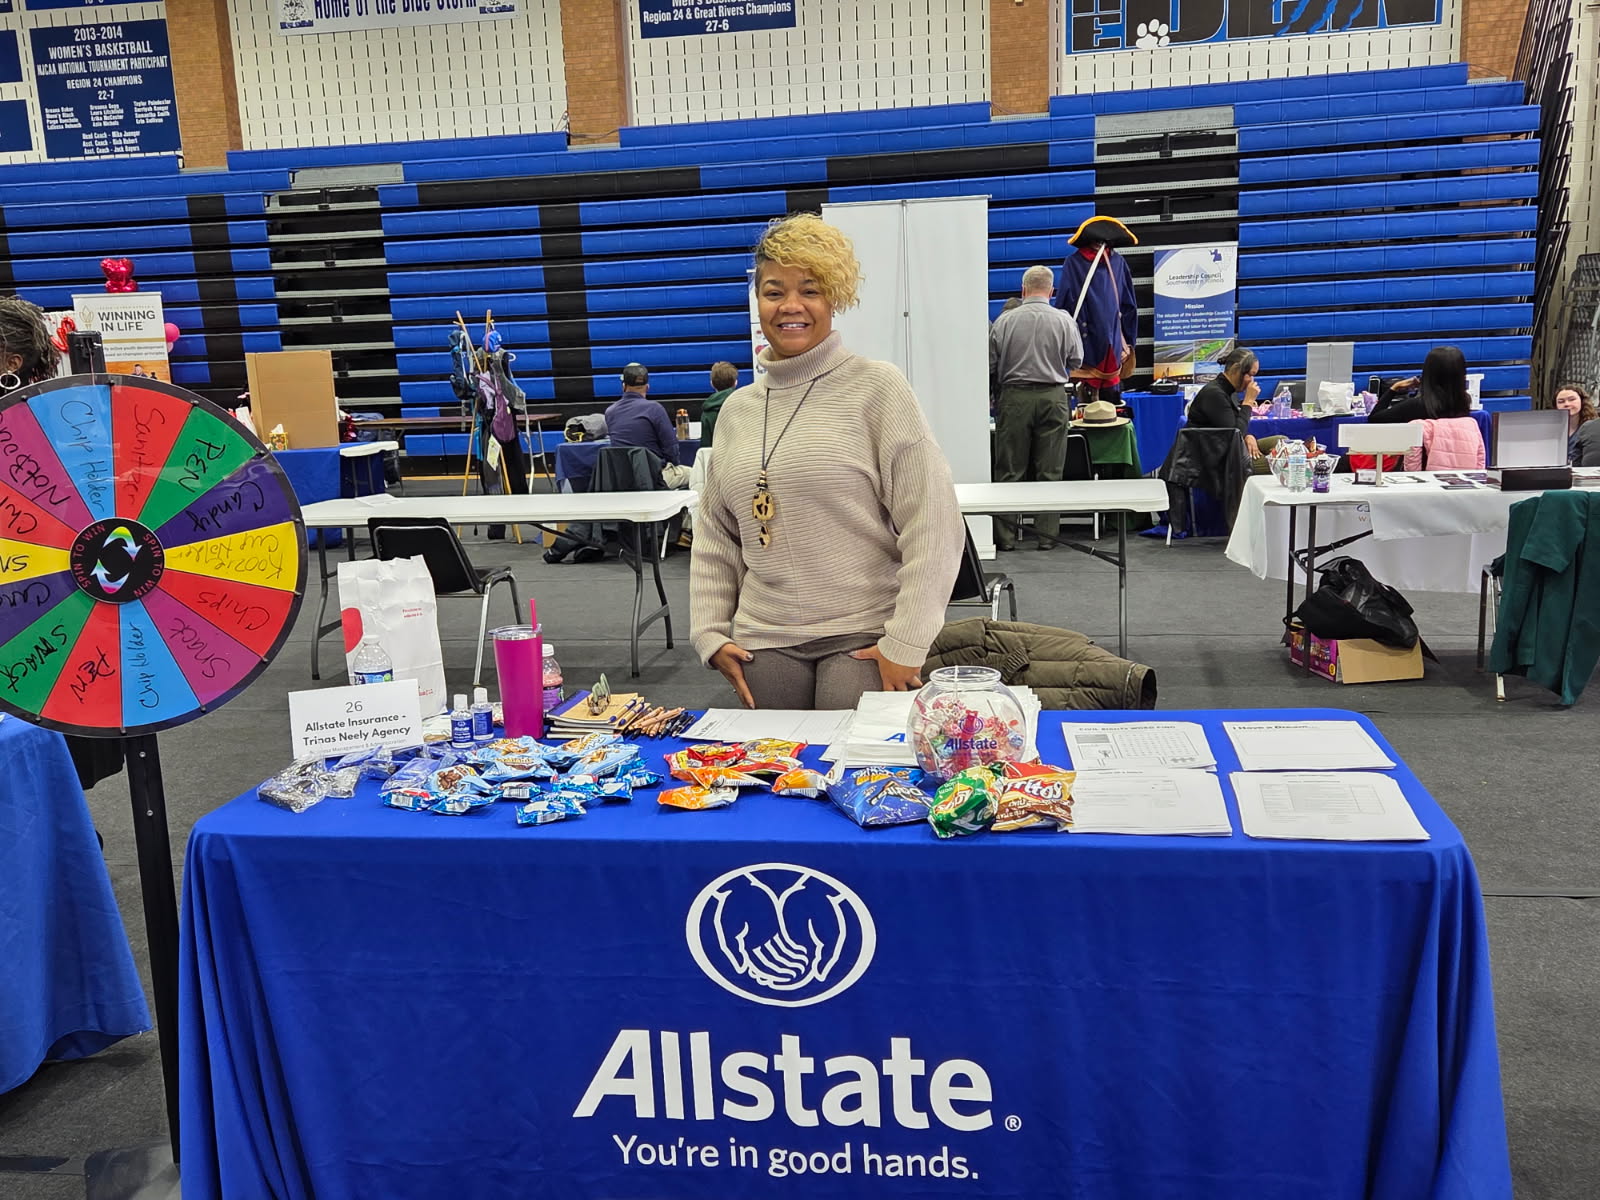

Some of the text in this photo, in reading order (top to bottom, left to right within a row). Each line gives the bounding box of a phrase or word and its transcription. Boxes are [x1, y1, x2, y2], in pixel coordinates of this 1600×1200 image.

[643, 11, 672, 24] Region
[673, 10, 684, 21] 24
[685, 9, 693, 20] &
[694, 7, 717, 19] Great
[718, 5, 744, 17] Rivers
[746, 2, 791, 15] Champions
[74, 25, 123, 41] 2013-2014
[705, 19, 730, 32] 27-6
[48, 40, 153, 60] WOMEN'S BASKETBALL
[58, 61, 87, 75] NATIONAL
[88, 58, 129, 72] TOURNAMENT
[130, 56, 168, 70] PARTICIPANT
[66, 75, 143, 90] REGION 24 CHAMPIONS
[98, 90, 114, 101] 22-7
[98, 310, 155, 321] WINNING
[101, 321, 143, 331] IN LIFE
[82, 524, 106, 541] WIN
[143, 533, 162, 557] SPIN
[73, 563, 92, 588] SPIN
[133, 580, 156, 597] WIN
[345, 701, 363, 713] 26
[305, 719, 346, 732] Allstate
[347, 714, 399, 727] Insurance
[339, 730, 369, 744] Neely
[372, 726, 411, 739] Agency
[944, 738, 997, 750] Allstate
[572, 1029, 993, 1131] Allstate
[612, 1134, 979, 1180] You're in good hands.
